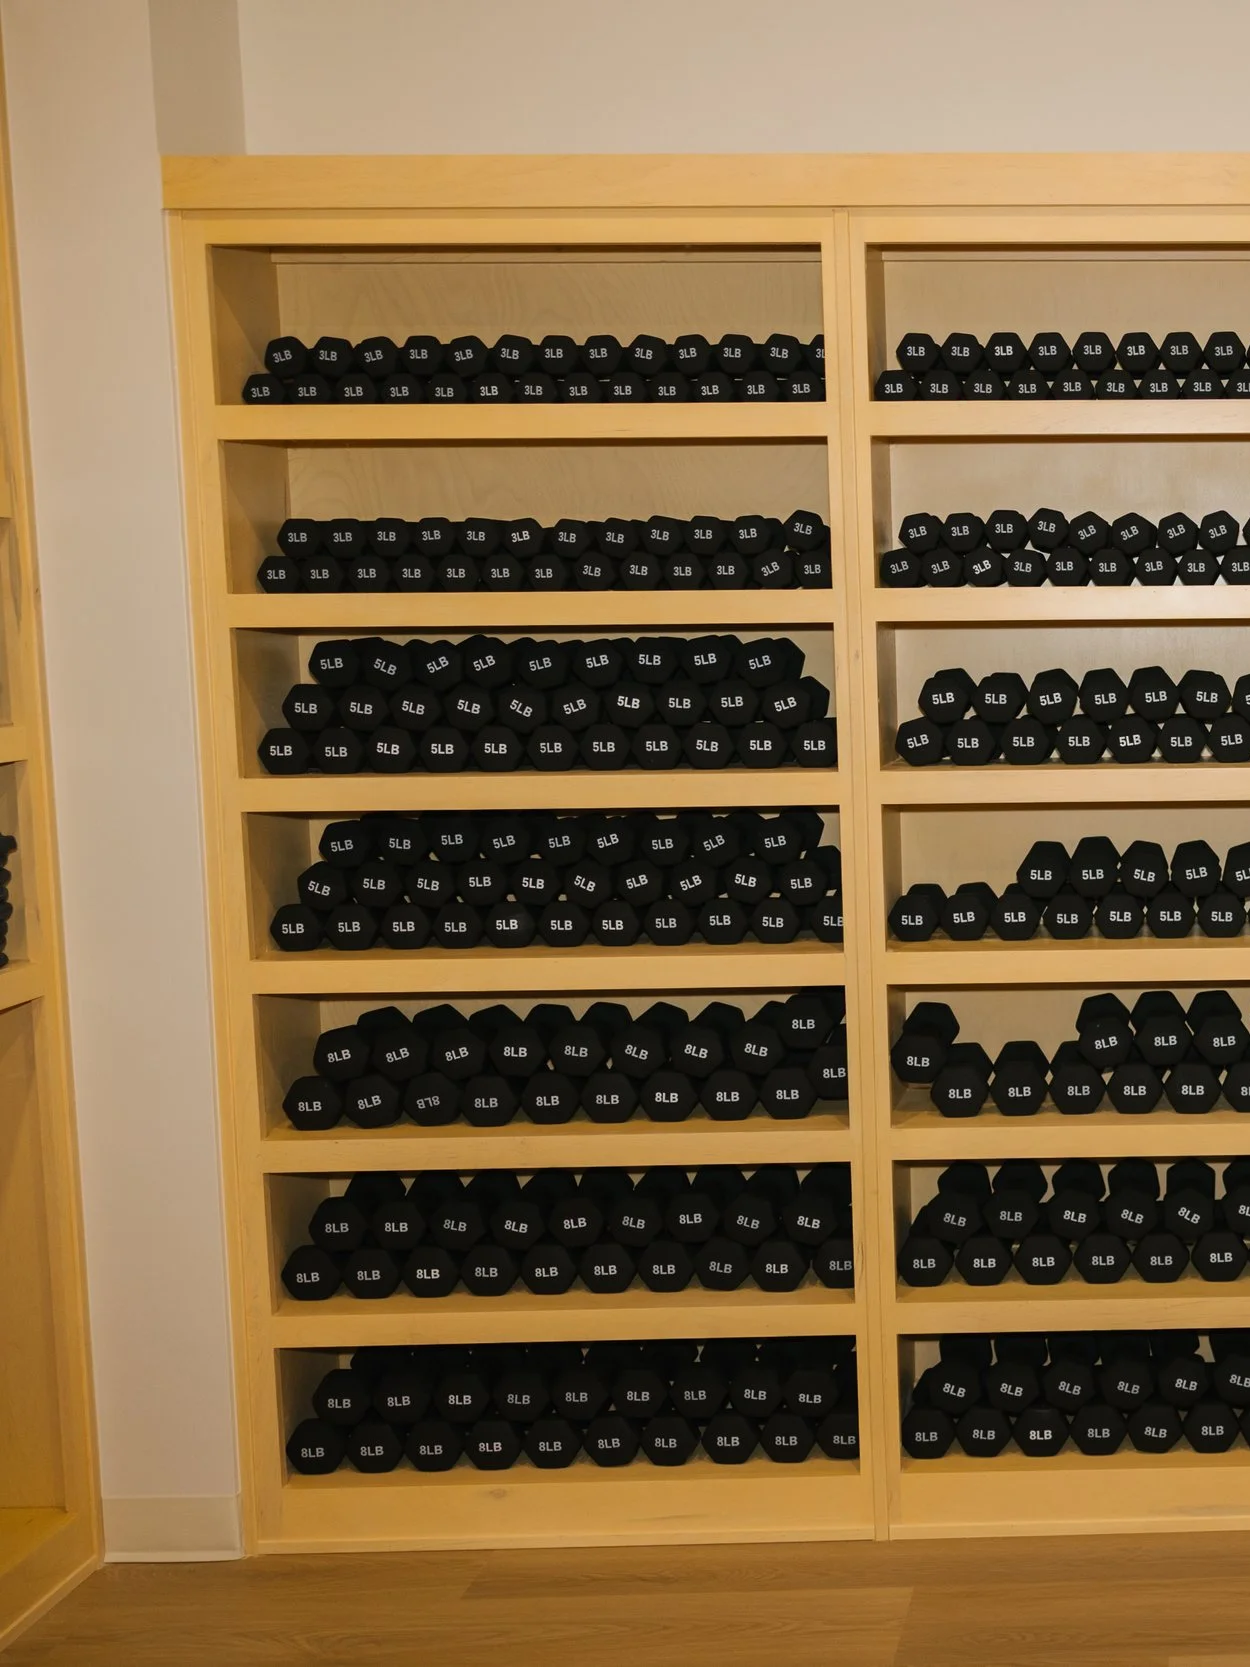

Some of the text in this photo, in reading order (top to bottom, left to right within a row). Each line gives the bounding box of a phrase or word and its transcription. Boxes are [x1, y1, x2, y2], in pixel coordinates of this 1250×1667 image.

[453, 348, 474, 362] 3LB
[950, 345, 970, 357] 3LB
[343, 385, 364, 398] 3LB
[479, 385, 499, 397] 3LB
[568, 385, 589, 397] 3LB
[613, 385, 633, 396] 3LB
[700, 384, 720, 397] 3LB
[746, 383, 766, 396] 3LB
[884, 382, 904, 394] 3LB
[1062, 381, 1082, 393] 3LB
[1105, 381, 1126, 394] 3LB
[510, 530, 531, 543] 3LB
[557, 531, 577, 544] 3LB
[738, 527, 758, 540] 3LB
[1120, 525, 1140, 541] 3LB
[356, 567, 377, 579] 3LB
[628, 564, 649, 576] 3LB
[716, 564, 736, 576] 3LB
[972, 559, 992, 575] 3LB
[1013, 560, 1033, 573] 3LB
[1231, 561, 1250, 573] 3LB
[534, 568, 554, 579] 3LB
[616, 695, 641, 710] 5LB
[773, 696, 798, 713] 5LB
[931, 691, 956, 705] 5LB
[1038, 691, 1063, 707] 5LB
[695, 739, 719, 753] 5LB
[749, 739, 773, 752] 5LB
[1118, 733, 1142, 748] 5LB
[1220, 733, 1244, 747] 5LB
[375, 741, 400, 756] 5LB
[430, 743, 455, 755] 5LB
[483, 742, 508, 755] 5LB
[592, 741, 616, 753] 5LB
[734, 873, 758, 888] 5LB
[1132, 868, 1156, 883] 5LB
[521, 876, 545, 890] 5LB
[679, 874, 703, 892] 5LB
[952, 911, 976, 924] 5LB
[1003, 911, 1027, 924] 5LB
[1108, 910, 1133, 923] 5LB
[392, 920, 416, 933] 5LB
[495, 918, 519, 931] 5LB
[550, 919, 574, 931] 5LB
[601, 919, 625, 931] 5LB
[791, 1018, 816, 1030] 8LB
[1094, 1035, 1119, 1050] 8LB
[327, 1048, 352, 1063] 8LB
[444, 1046, 470, 1062] 8LB
[503, 1045, 528, 1058] 8LB
[683, 1043, 709, 1059] 8LB
[947, 1088, 973, 1100] 8LB
[1122, 1085, 1147, 1096] 8LB
[1180, 1084, 1205, 1096] 8LB
[654, 1091, 679, 1104] 8LB
[715, 1091, 740, 1103] 8LB
[562, 1216, 588, 1230] 8LB
[678, 1212, 703, 1225] 8LB
[796, 1215, 821, 1230] 8LB
[1062, 1209, 1087, 1224] 8LB
[972, 1257, 997, 1269] 8LB
[1031, 1256, 1056, 1268] 8LB
[1209, 1251, 1234, 1264] 8LB
[415, 1268, 441, 1280] 8LB
[534, 1266, 559, 1278] 8LB
[593, 1264, 618, 1276] 8LB
[765, 1263, 789, 1275] 8LB
[999, 1382, 1024, 1397] 8LB
[1174, 1377, 1198, 1392] 8LB
[386, 1395, 411, 1408] 8LB
[447, 1394, 472, 1406] 8LB
[798, 1392, 822, 1404] 8LB
[1028, 1429, 1053, 1441] 8LB
[1143, 1425, 1168, 1439] 8LB
[1200, 1425, 1225, 1436] 8LB
[478, 1441, 503, 1453] 8LB
[597, 1437, 621, 1450] 8LB
[654, 1437, 678, 1449] 8LB
[716, 1435, 740, 1447] 8LB
